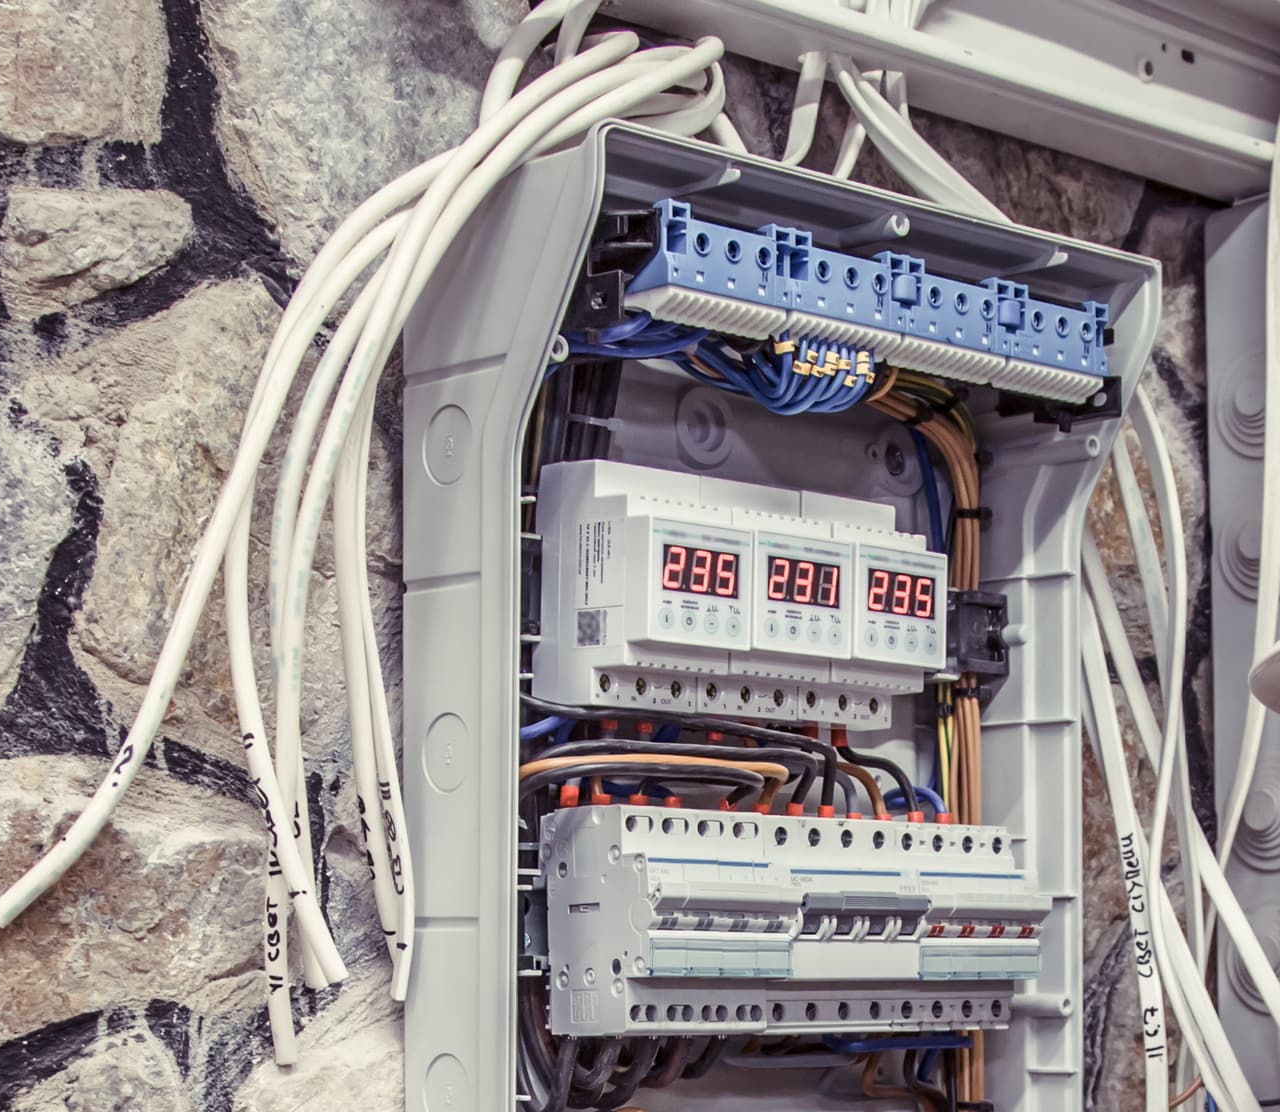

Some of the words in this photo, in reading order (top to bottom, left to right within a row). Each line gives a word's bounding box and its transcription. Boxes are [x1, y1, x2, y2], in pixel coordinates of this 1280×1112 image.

[662, 545, 736, 597] 235
[768, 558, 839, 606] 231
[868, 570, 933, 618] 235
